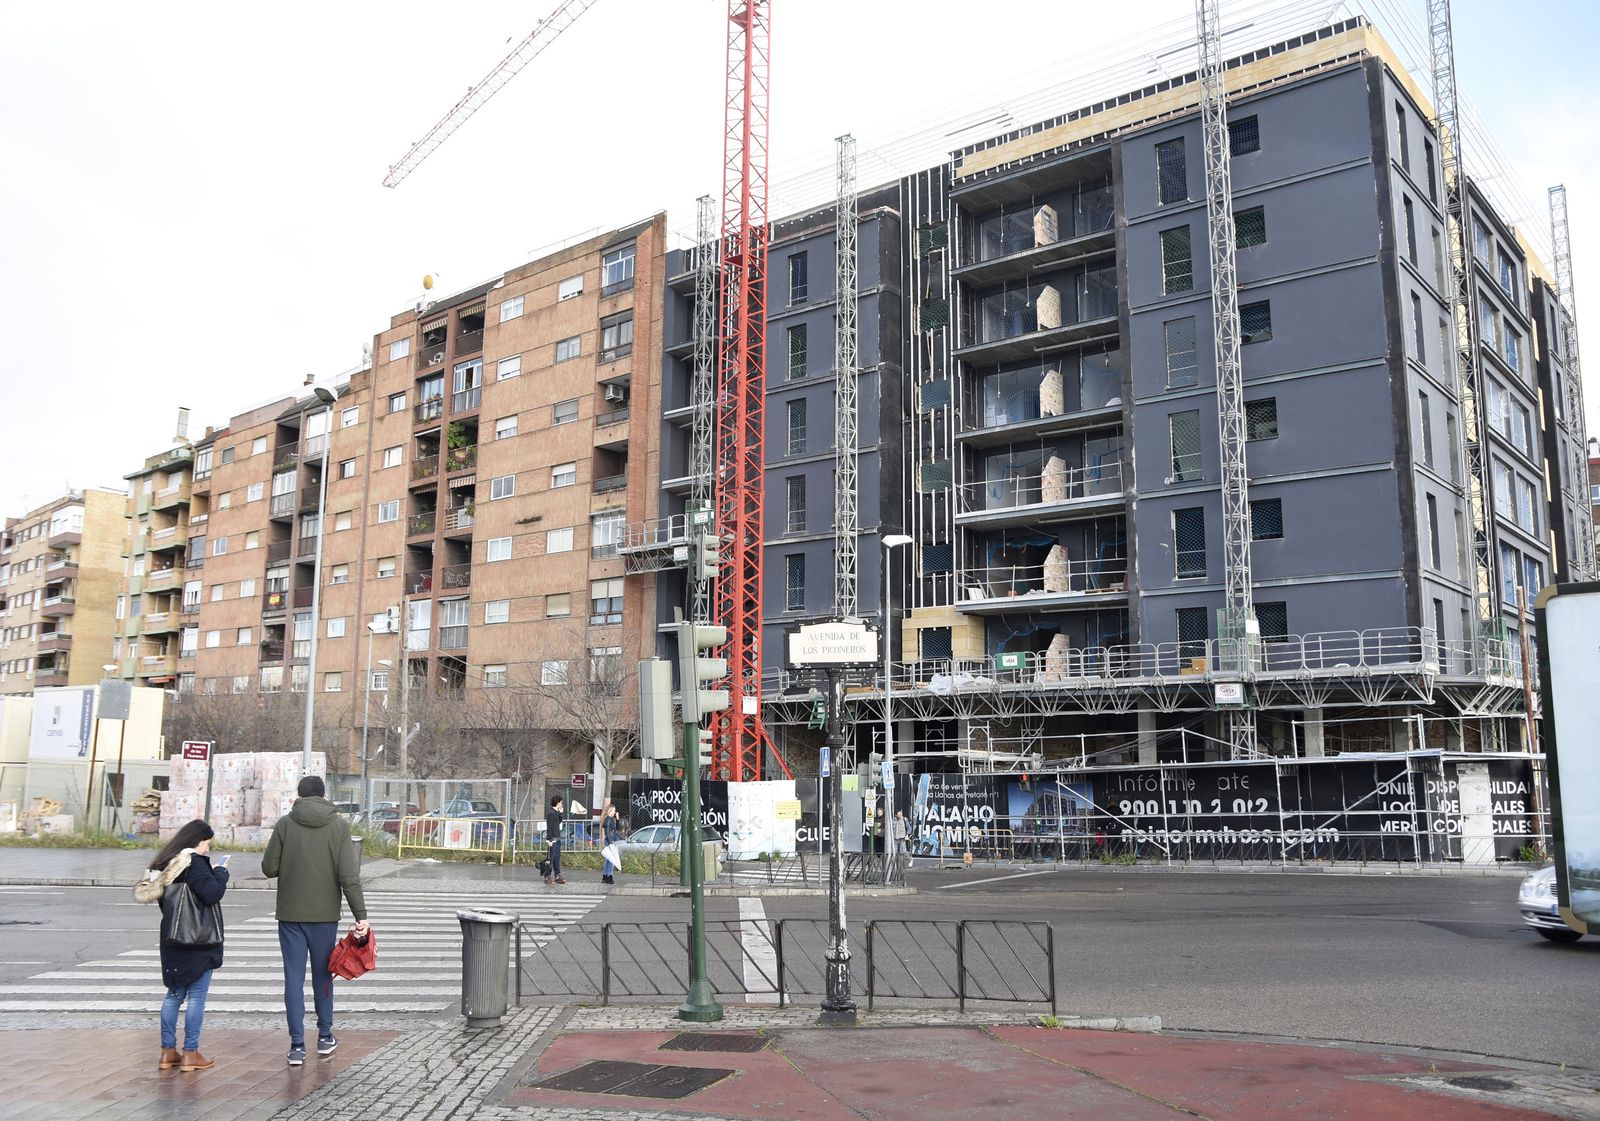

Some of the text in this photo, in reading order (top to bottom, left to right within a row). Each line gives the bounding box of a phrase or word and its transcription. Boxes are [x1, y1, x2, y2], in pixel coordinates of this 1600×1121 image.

[808, 632, 860, 641] AVENIDA DE
[803, 645, 866, 654] LOS PICONEROS
[1119, 799, 1159, 815] 900
[918, 804, 995, 823] PALACIO
